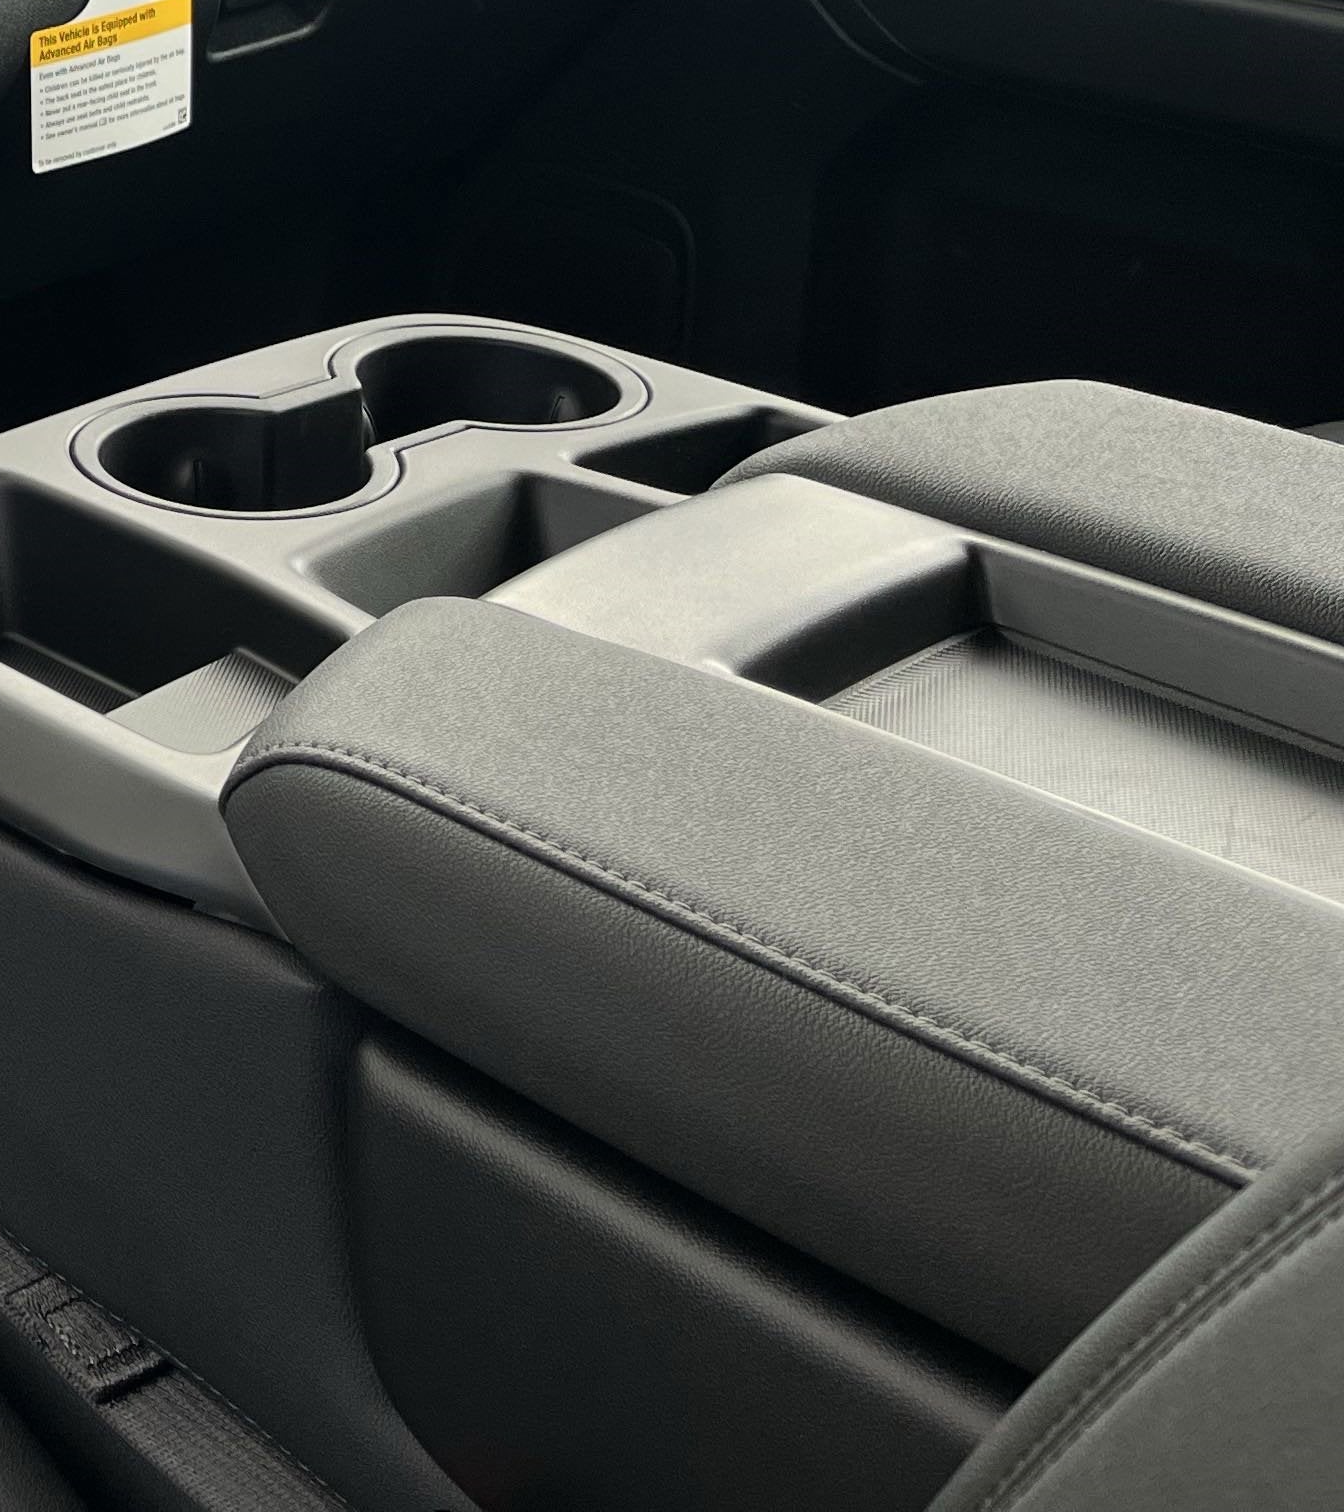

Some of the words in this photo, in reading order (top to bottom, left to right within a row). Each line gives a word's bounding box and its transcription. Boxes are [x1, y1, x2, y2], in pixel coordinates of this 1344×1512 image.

[39, 34, 57, 48] This
[59, 25, 89, 42] Vehicle
[102, 11, 137, 32] Equipped
[139, 7, 156, 21] with
[39, 42, 81, 62] Advanced
[83, 38, 95, 51] Air
[97, 34, 118, 47] Bags
